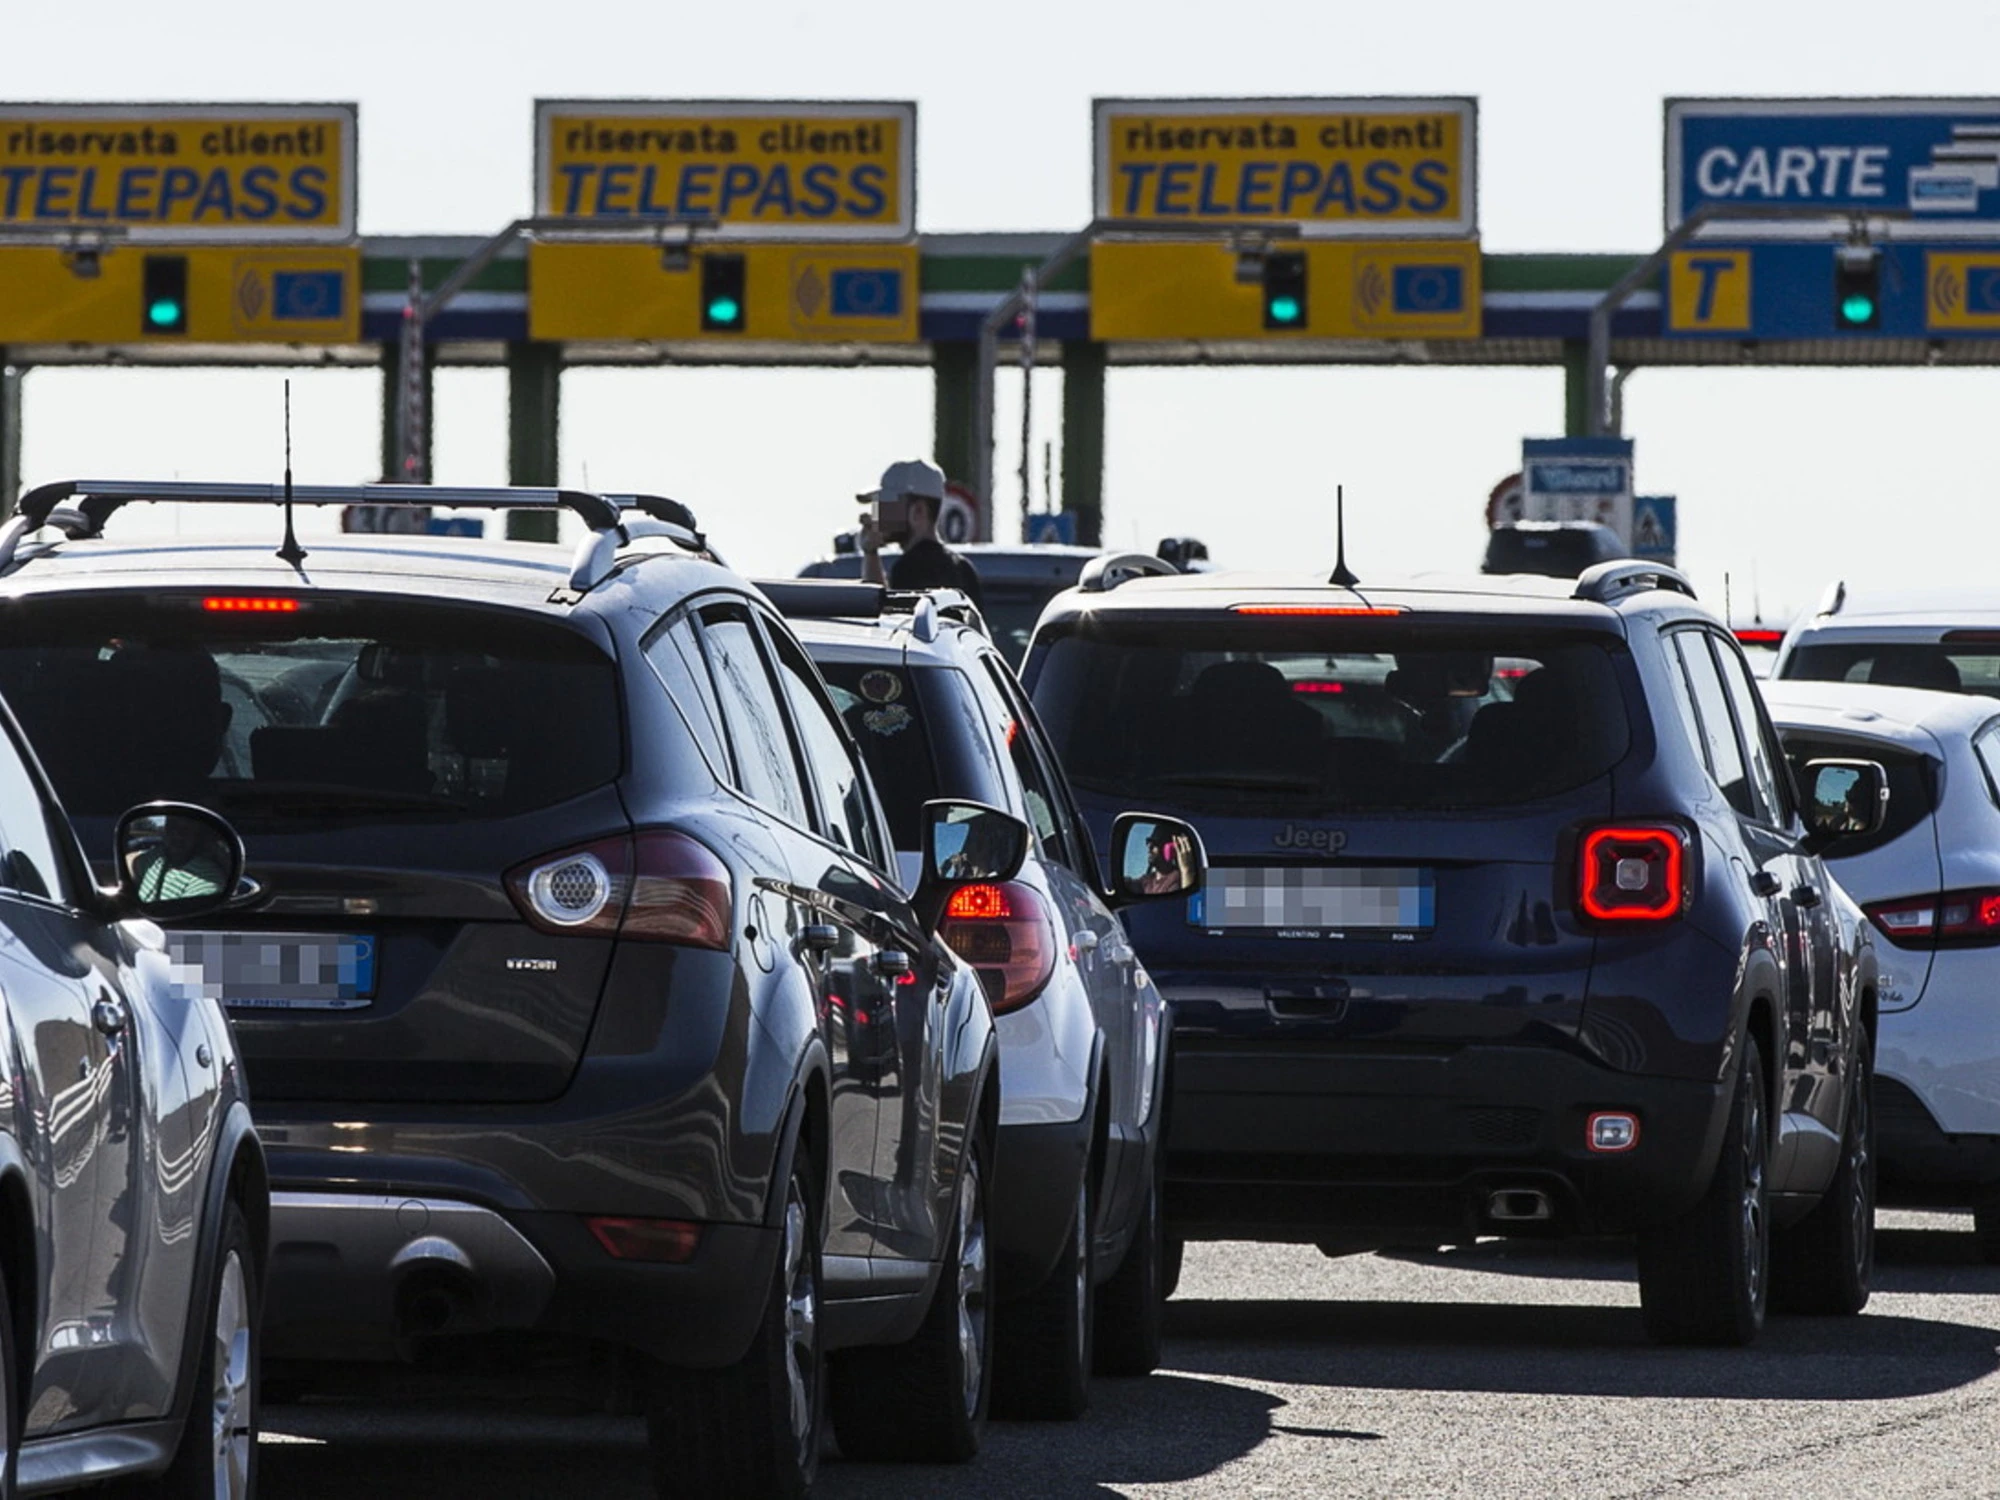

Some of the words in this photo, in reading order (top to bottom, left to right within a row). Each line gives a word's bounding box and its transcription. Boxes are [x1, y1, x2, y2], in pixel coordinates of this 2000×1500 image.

[8, 125, 179, 156] riservata
[201, 125, 326, 156] clienti
[566, 122, 738, 153] riservata
[758, 121, 883, 153] clienti
[1125, 120, 1297, 151] riservata
[1318, 118, 1444, 150] clienti
[0, 165, 328, 220] TELEPASS
[559, 162, 888, 218] TELEPASS
[1119, 160, 1449, 215] TELEPASS
[1696, 146, 1890, 197] CARTE
[1687, 257, 1735, 323] T
[1274, 824, 1347, 850] Jeep
